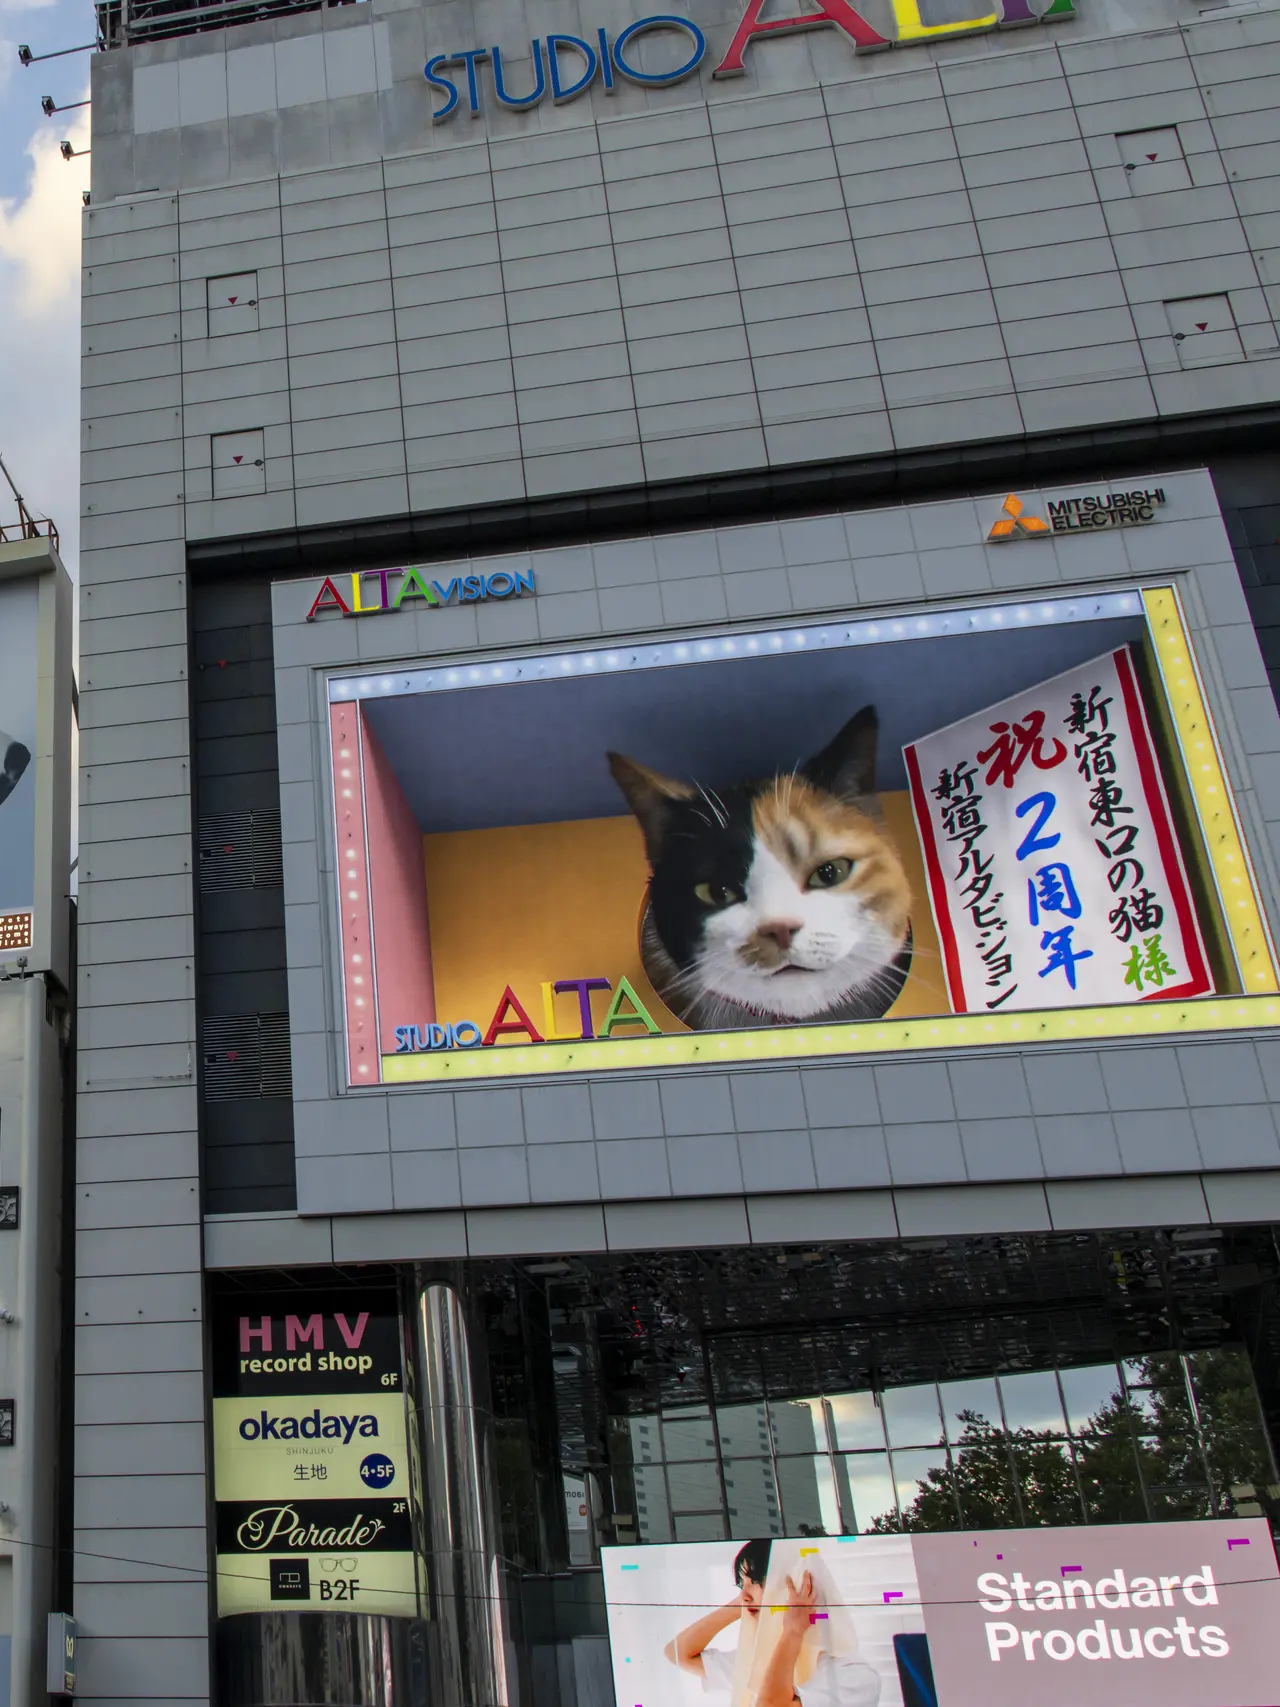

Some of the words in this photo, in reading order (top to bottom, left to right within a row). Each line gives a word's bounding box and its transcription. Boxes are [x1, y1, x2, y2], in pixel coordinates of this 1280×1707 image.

[423, 15, 706, 124] STUDIO
[1047, 488, 1166, 516] MITSUBISHI
[1050, 505, 1155, 532] ELECTRIC
[306, 566, 439, 622] ALTA
[432, 569, 536, 601] VISION
[976, 710, 1068, 789] 祝
[930, 761, 1019, 1009] 新宿アルタビジョン
[1015, 791, 1094, 991] 2周年
[393, 1019, 482, 1052] STUDIO
[481, 975, 663, 1046] ALTA
[239, 1312, 370, 1353] HMV
[240, 1352, 312, 1374] record
[318, 1351, 373, 1375] shop
[380, 1373, 398, 1386] 6F
[239, 1409, 380, 1445] okadaya
[285, 1446, 334, 1456] SHINJUKU
[293, 1463, 328, 1481] 生地
[236, 1504, 386, 1551] Parade
[392, 1502, 407, 1513] 2F
[319, 1579, 360, 1601] B2F
[976, 1565, 1219, 1613] Standard
[984, 1617, 1230, 1661] Products
